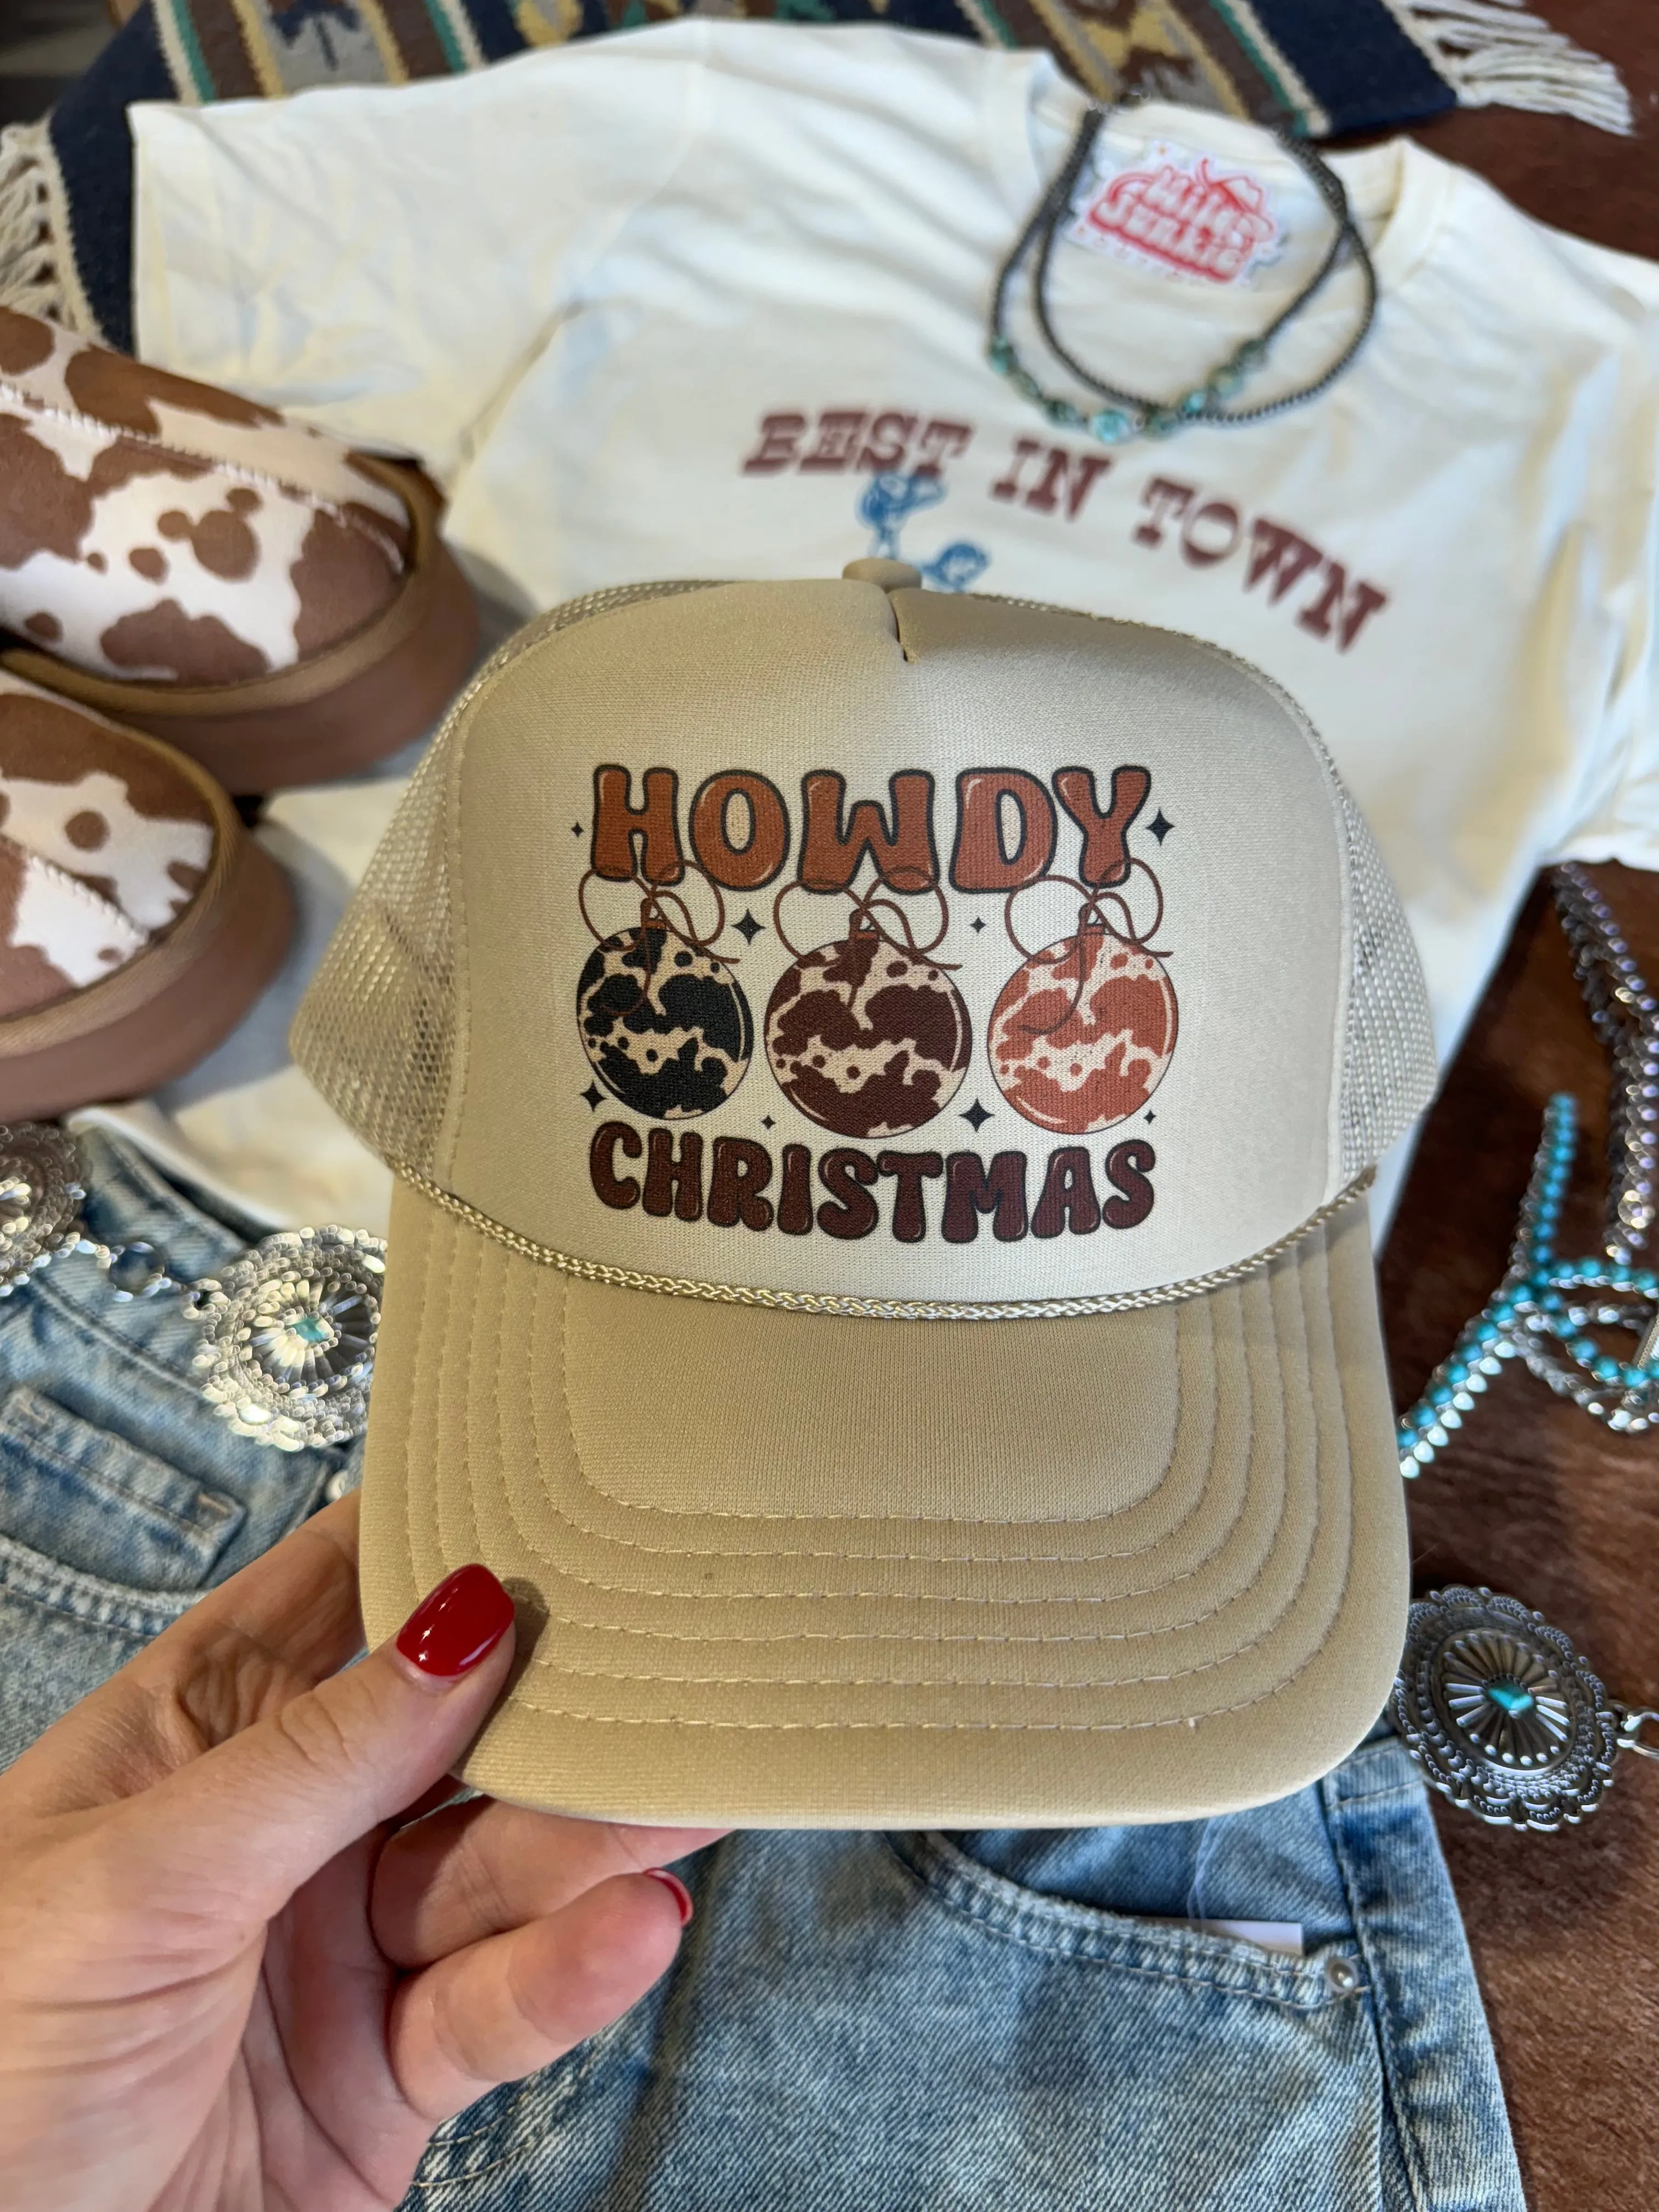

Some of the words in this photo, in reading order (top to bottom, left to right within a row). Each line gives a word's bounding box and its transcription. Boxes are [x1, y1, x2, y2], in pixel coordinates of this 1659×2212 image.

[743, 409, 974, 478] BEST
[992, 439, 1110, 520] IN
[1132, 476, 1388, 652] TOWN
[592, 765, 1152, 893] HOWDY
[589, 1120, 1155, 1243] CHRISTMAS
